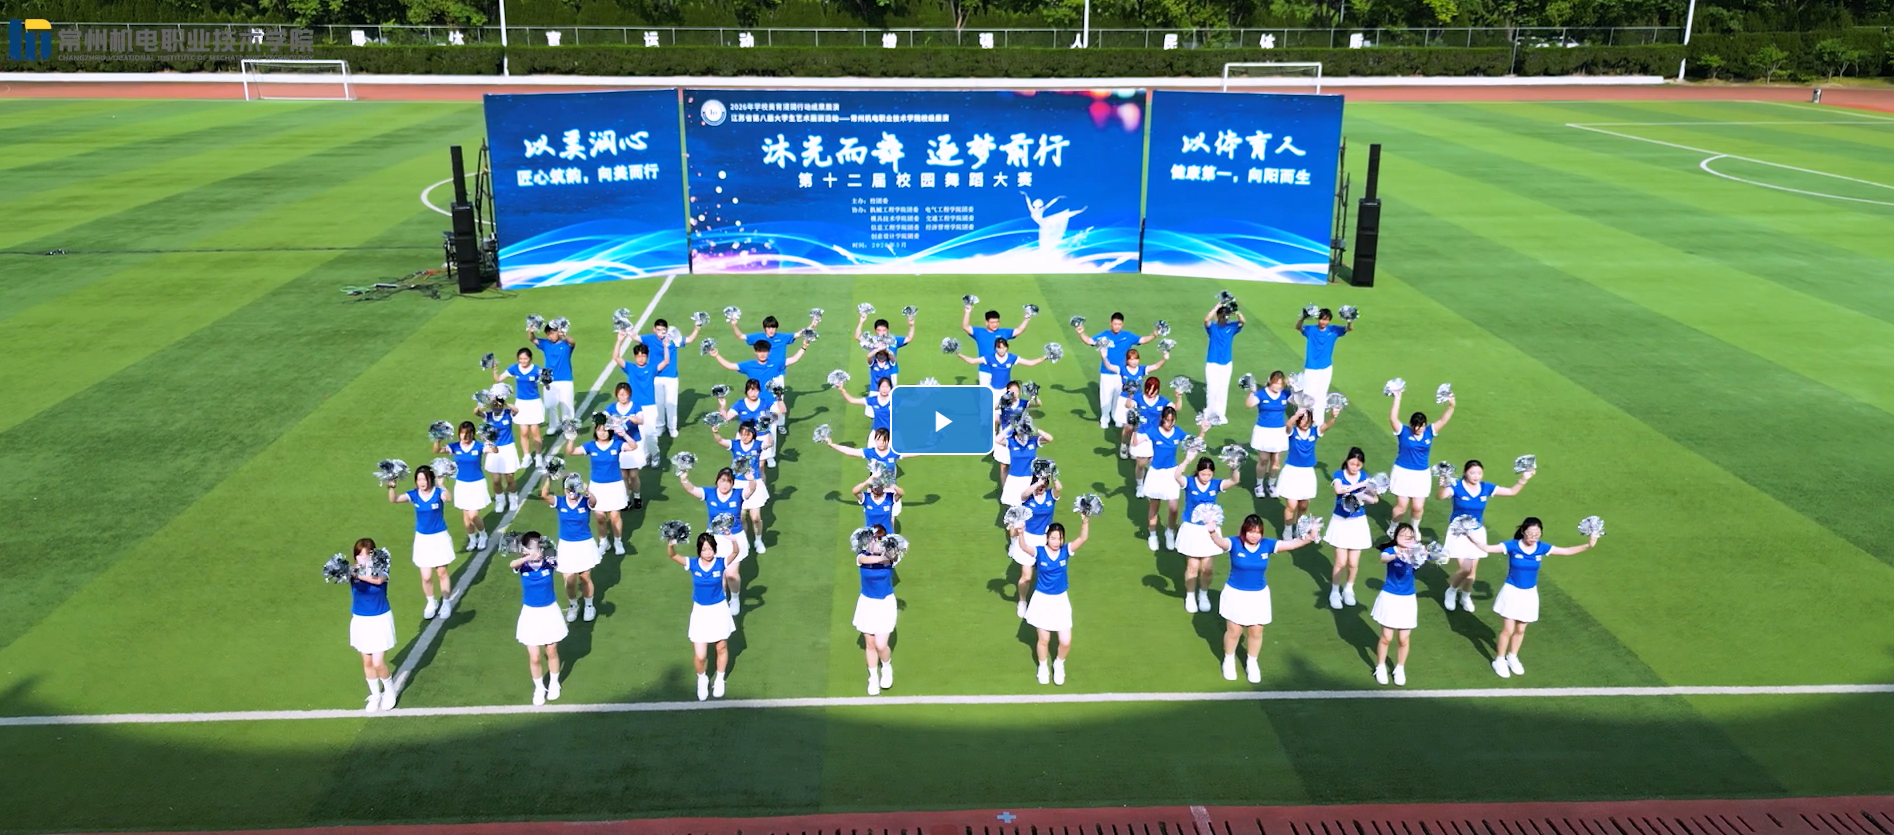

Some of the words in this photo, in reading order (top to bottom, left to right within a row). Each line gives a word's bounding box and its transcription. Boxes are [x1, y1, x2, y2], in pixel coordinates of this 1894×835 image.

[523, 129, 650, 161] 以美润心
[761, 131, 905, 173] 沐光而舞
[926, 132, 1071, 171] 逐梦前行
[1180, 129, 1307, 161] 以体育人
